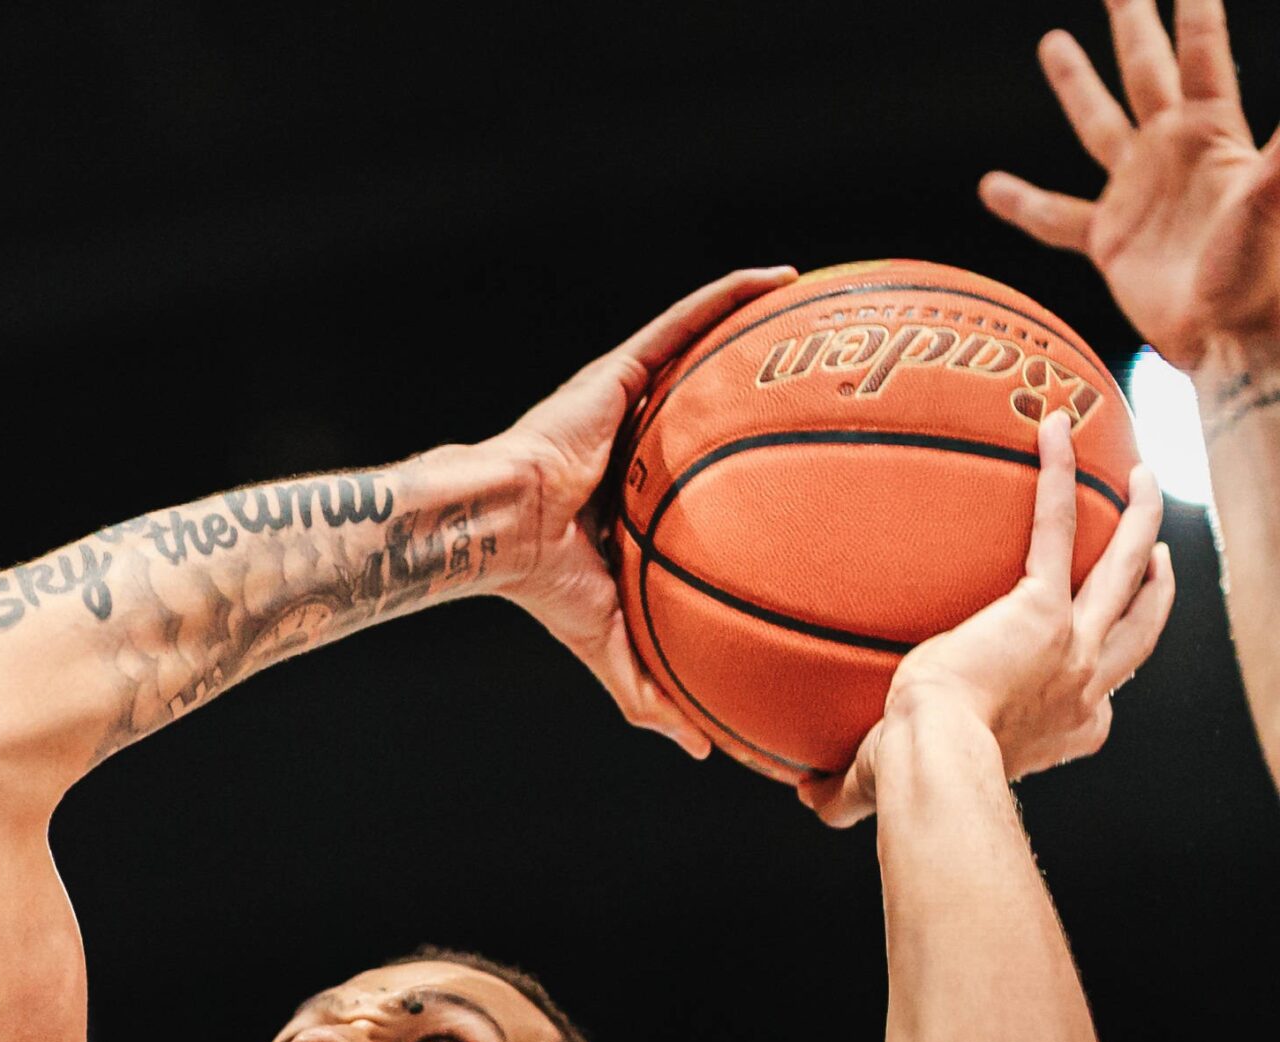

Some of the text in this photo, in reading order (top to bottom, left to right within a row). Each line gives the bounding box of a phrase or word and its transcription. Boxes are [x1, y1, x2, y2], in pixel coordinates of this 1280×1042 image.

[755, 323, 1104, 432] Baden
[142, 511, 239, 566] the
[223, 474, 394, 534] limit
